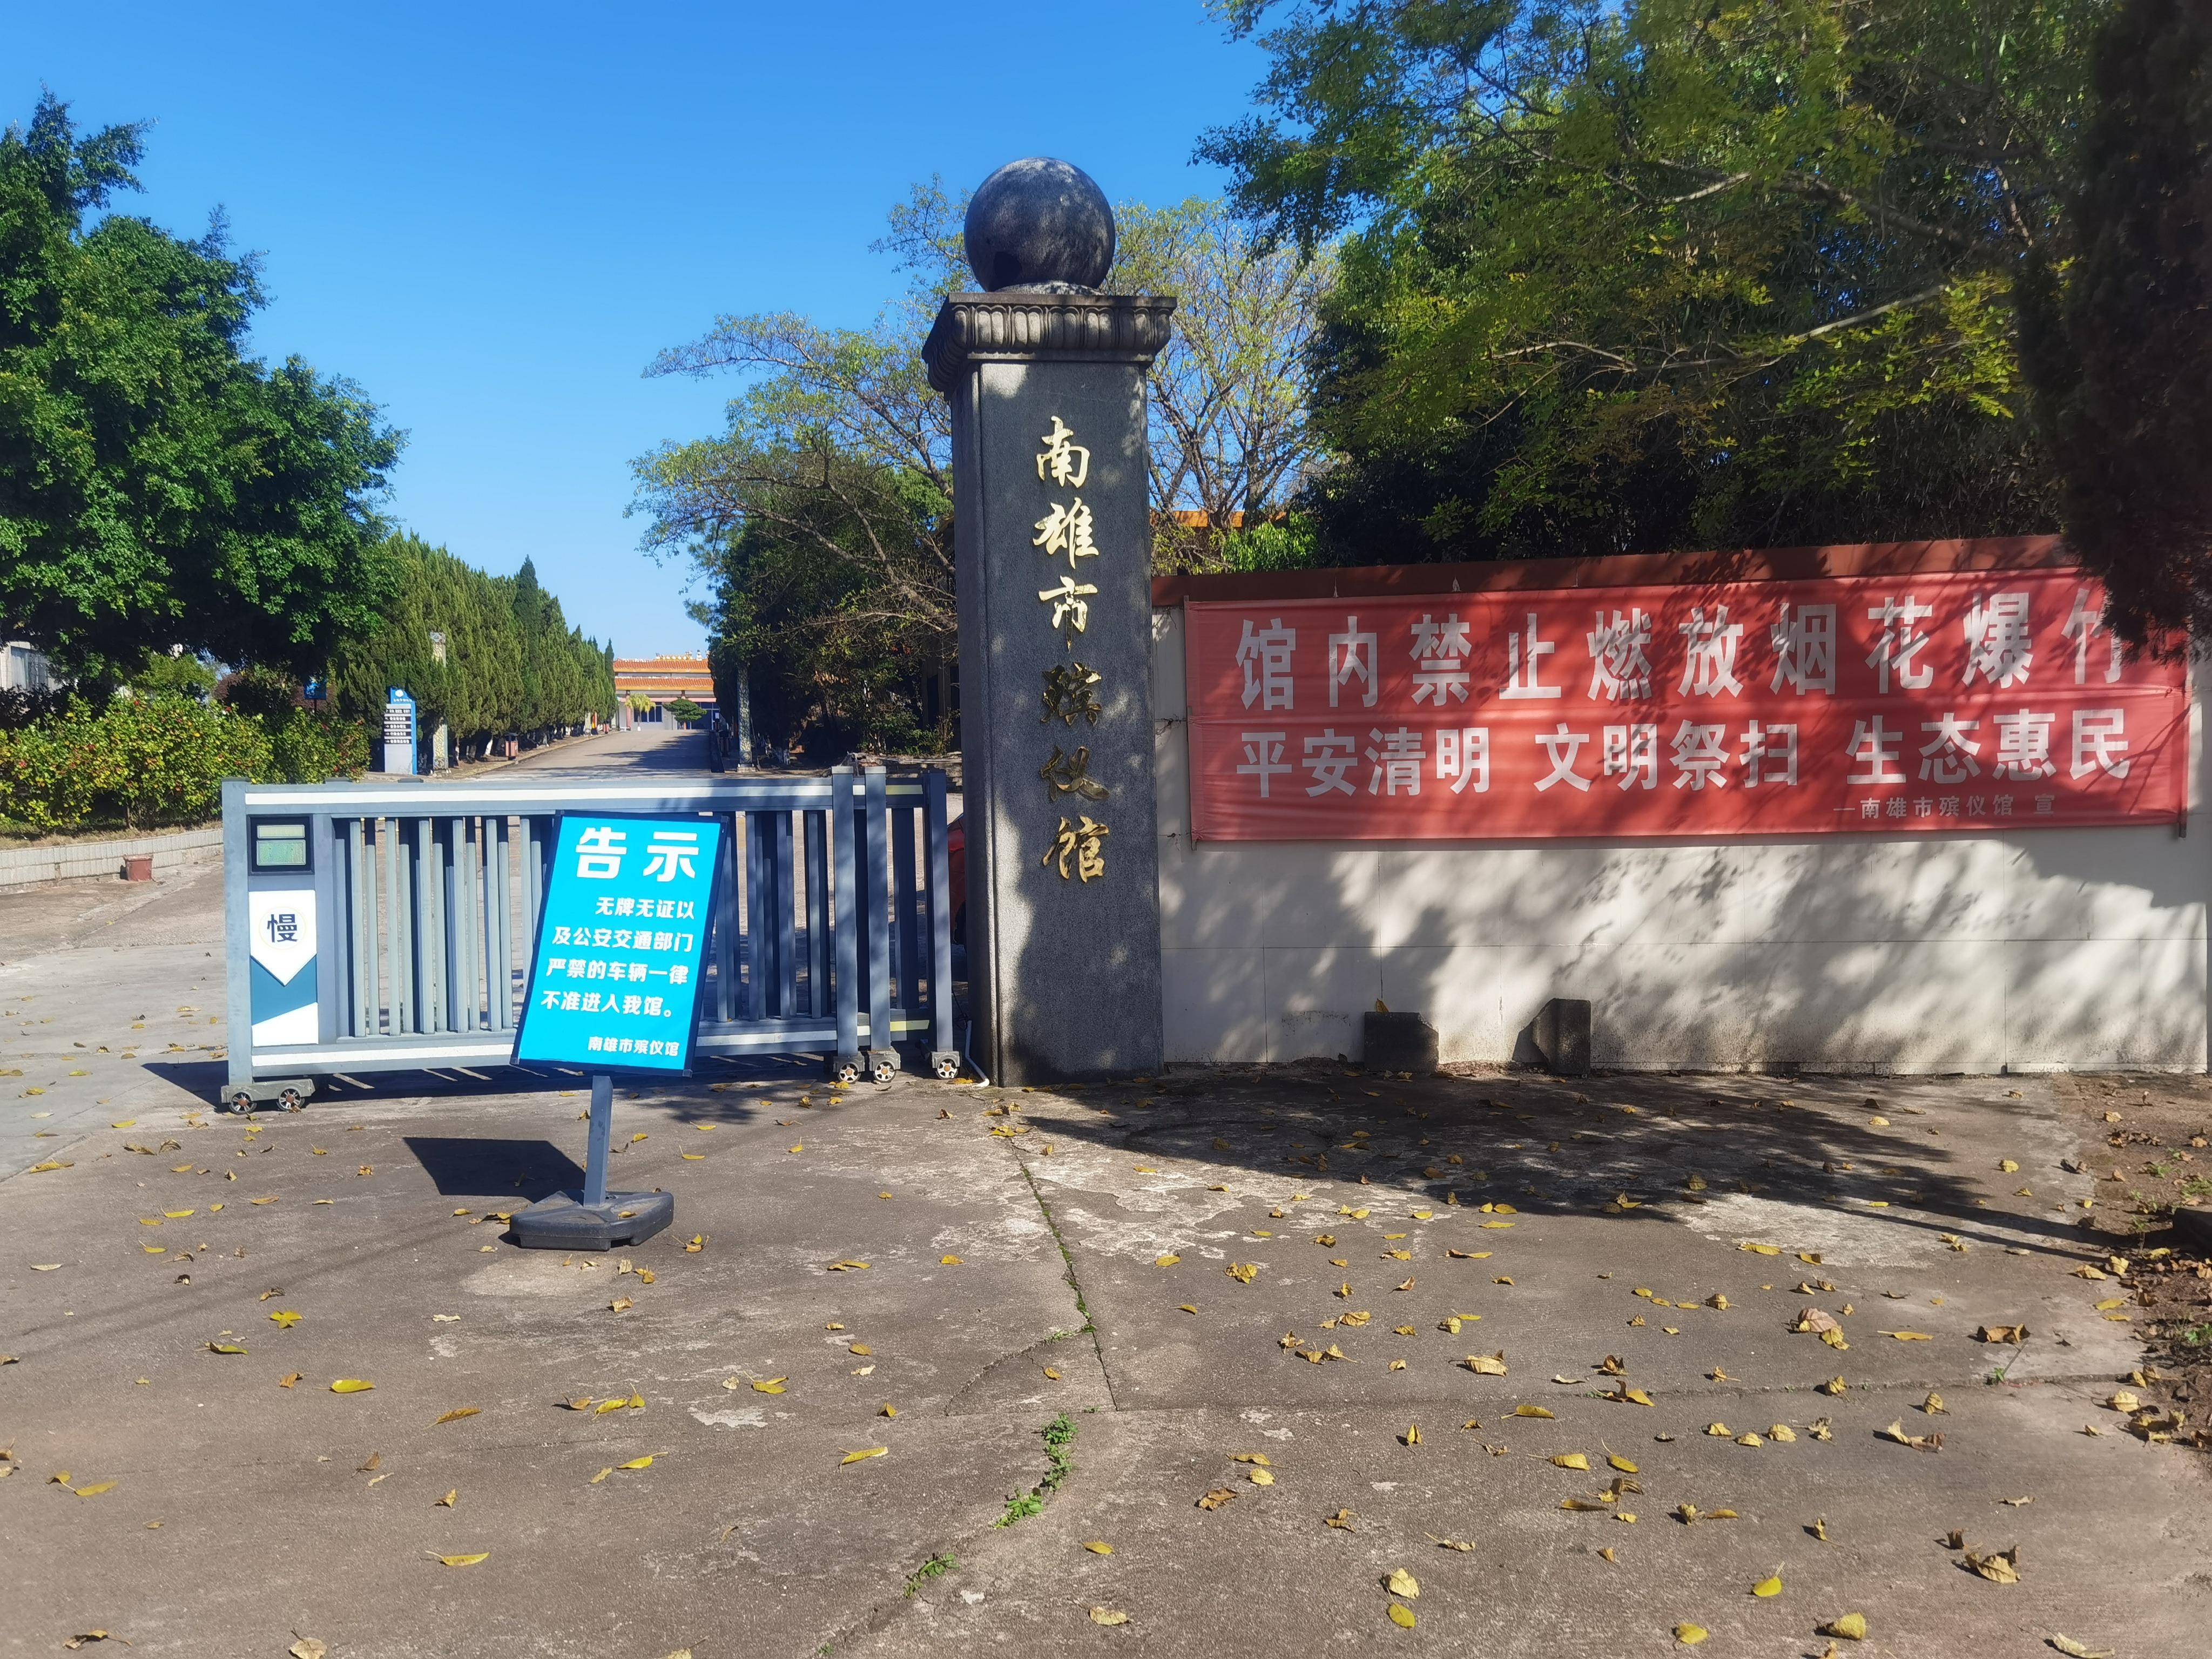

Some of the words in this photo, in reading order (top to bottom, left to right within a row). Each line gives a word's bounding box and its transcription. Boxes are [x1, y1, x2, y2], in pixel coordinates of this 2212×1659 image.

[1033, 415, 1110, 884] 南雄市殡仪馆
[1236, 588, 2123, 711] 馆内禁止燃放烟花爆竹
[1237, 727, 1489, 798] 平安清明
[1534, 719, 1798, 792] 文明祭扫
[1845, 708, 2130, 785] 生态惠民
[2034, 793, 2055, 815] 宣
[576, 827, 699, 882] 告示
[595, 896, 694, 920] 无牌无证以
[267, 913, 298, 943] 慢
[551, 926, 694, 952] 及公安交通部门
[545, 957, 689, 985] 严禁的车辆一律
[541, 990, 672, 1017] 不准进入我馆。
[588, 1036, 680, 1057] 南雄市殡仪馆
